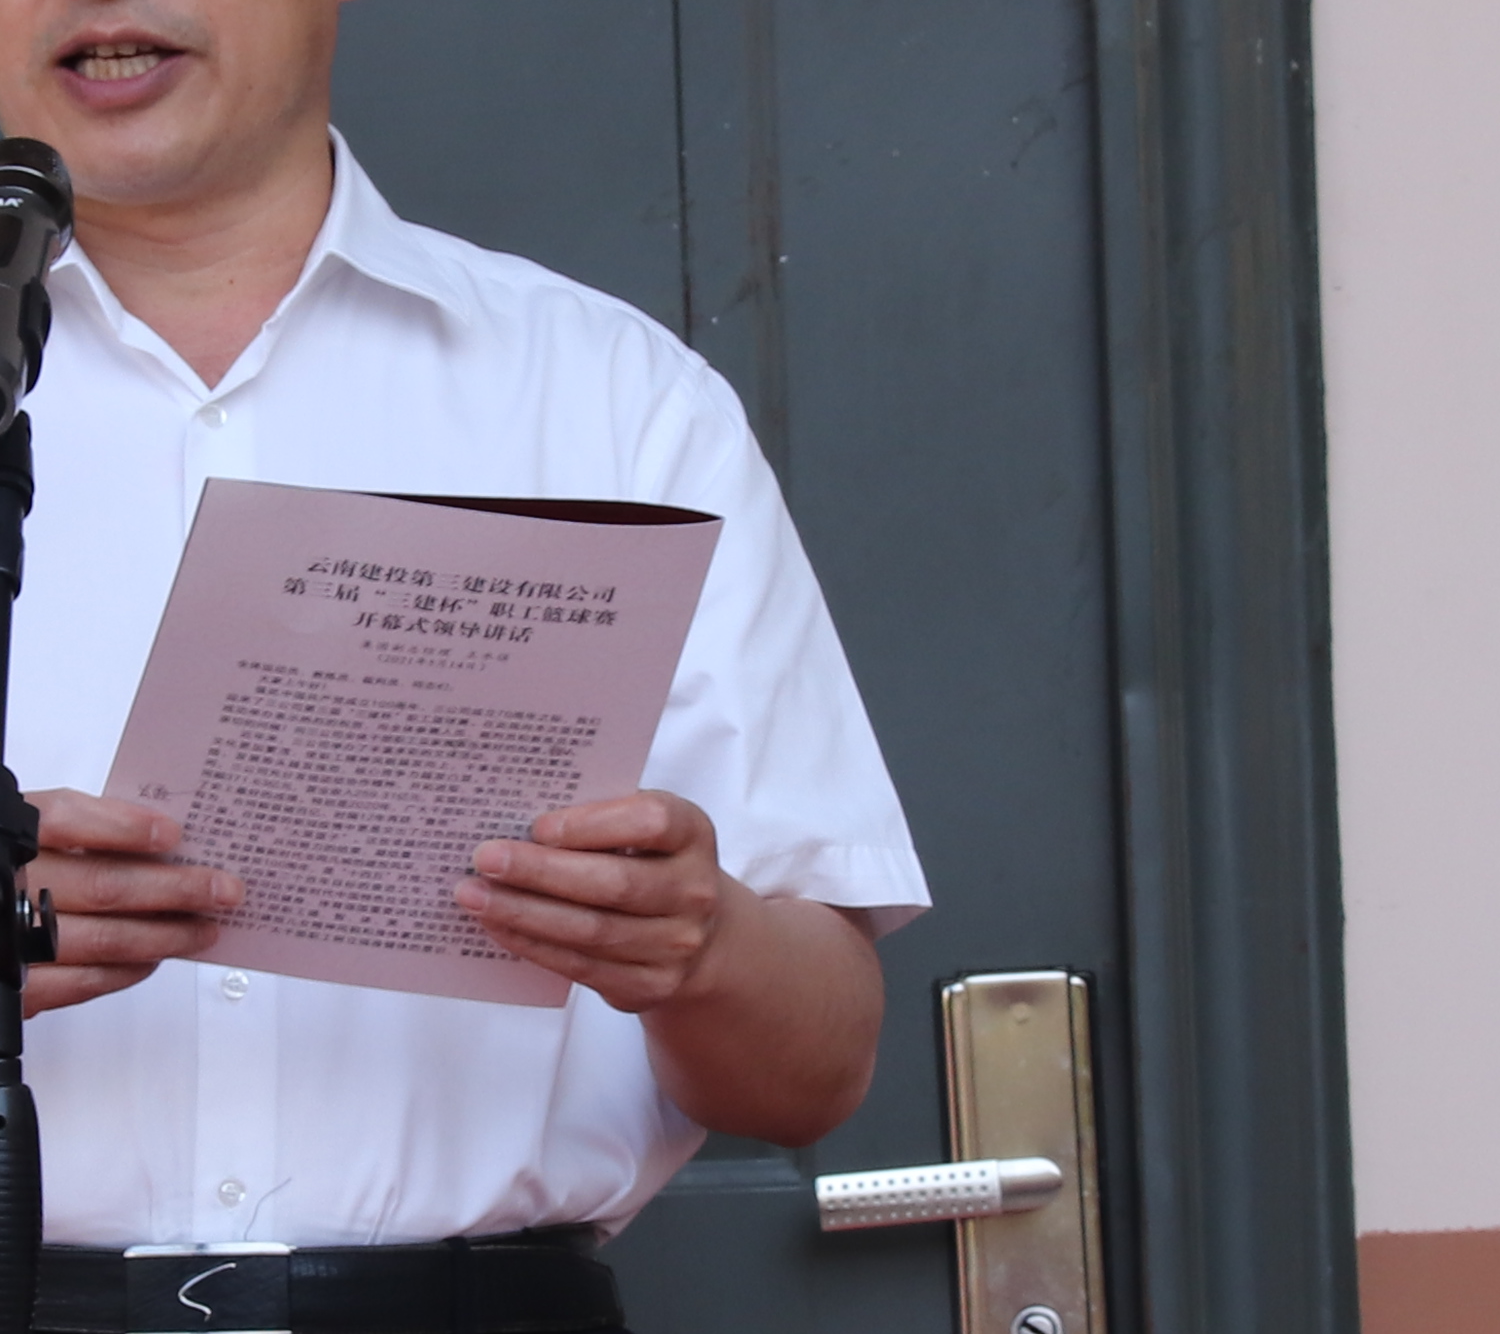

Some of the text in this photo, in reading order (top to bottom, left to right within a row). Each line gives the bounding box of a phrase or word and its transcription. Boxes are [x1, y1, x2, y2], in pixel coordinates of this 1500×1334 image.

[307, 556, 617, 604] 云南建投第三建设有限公司
[352, 610, 535, 644] 开幕式领导讲话
